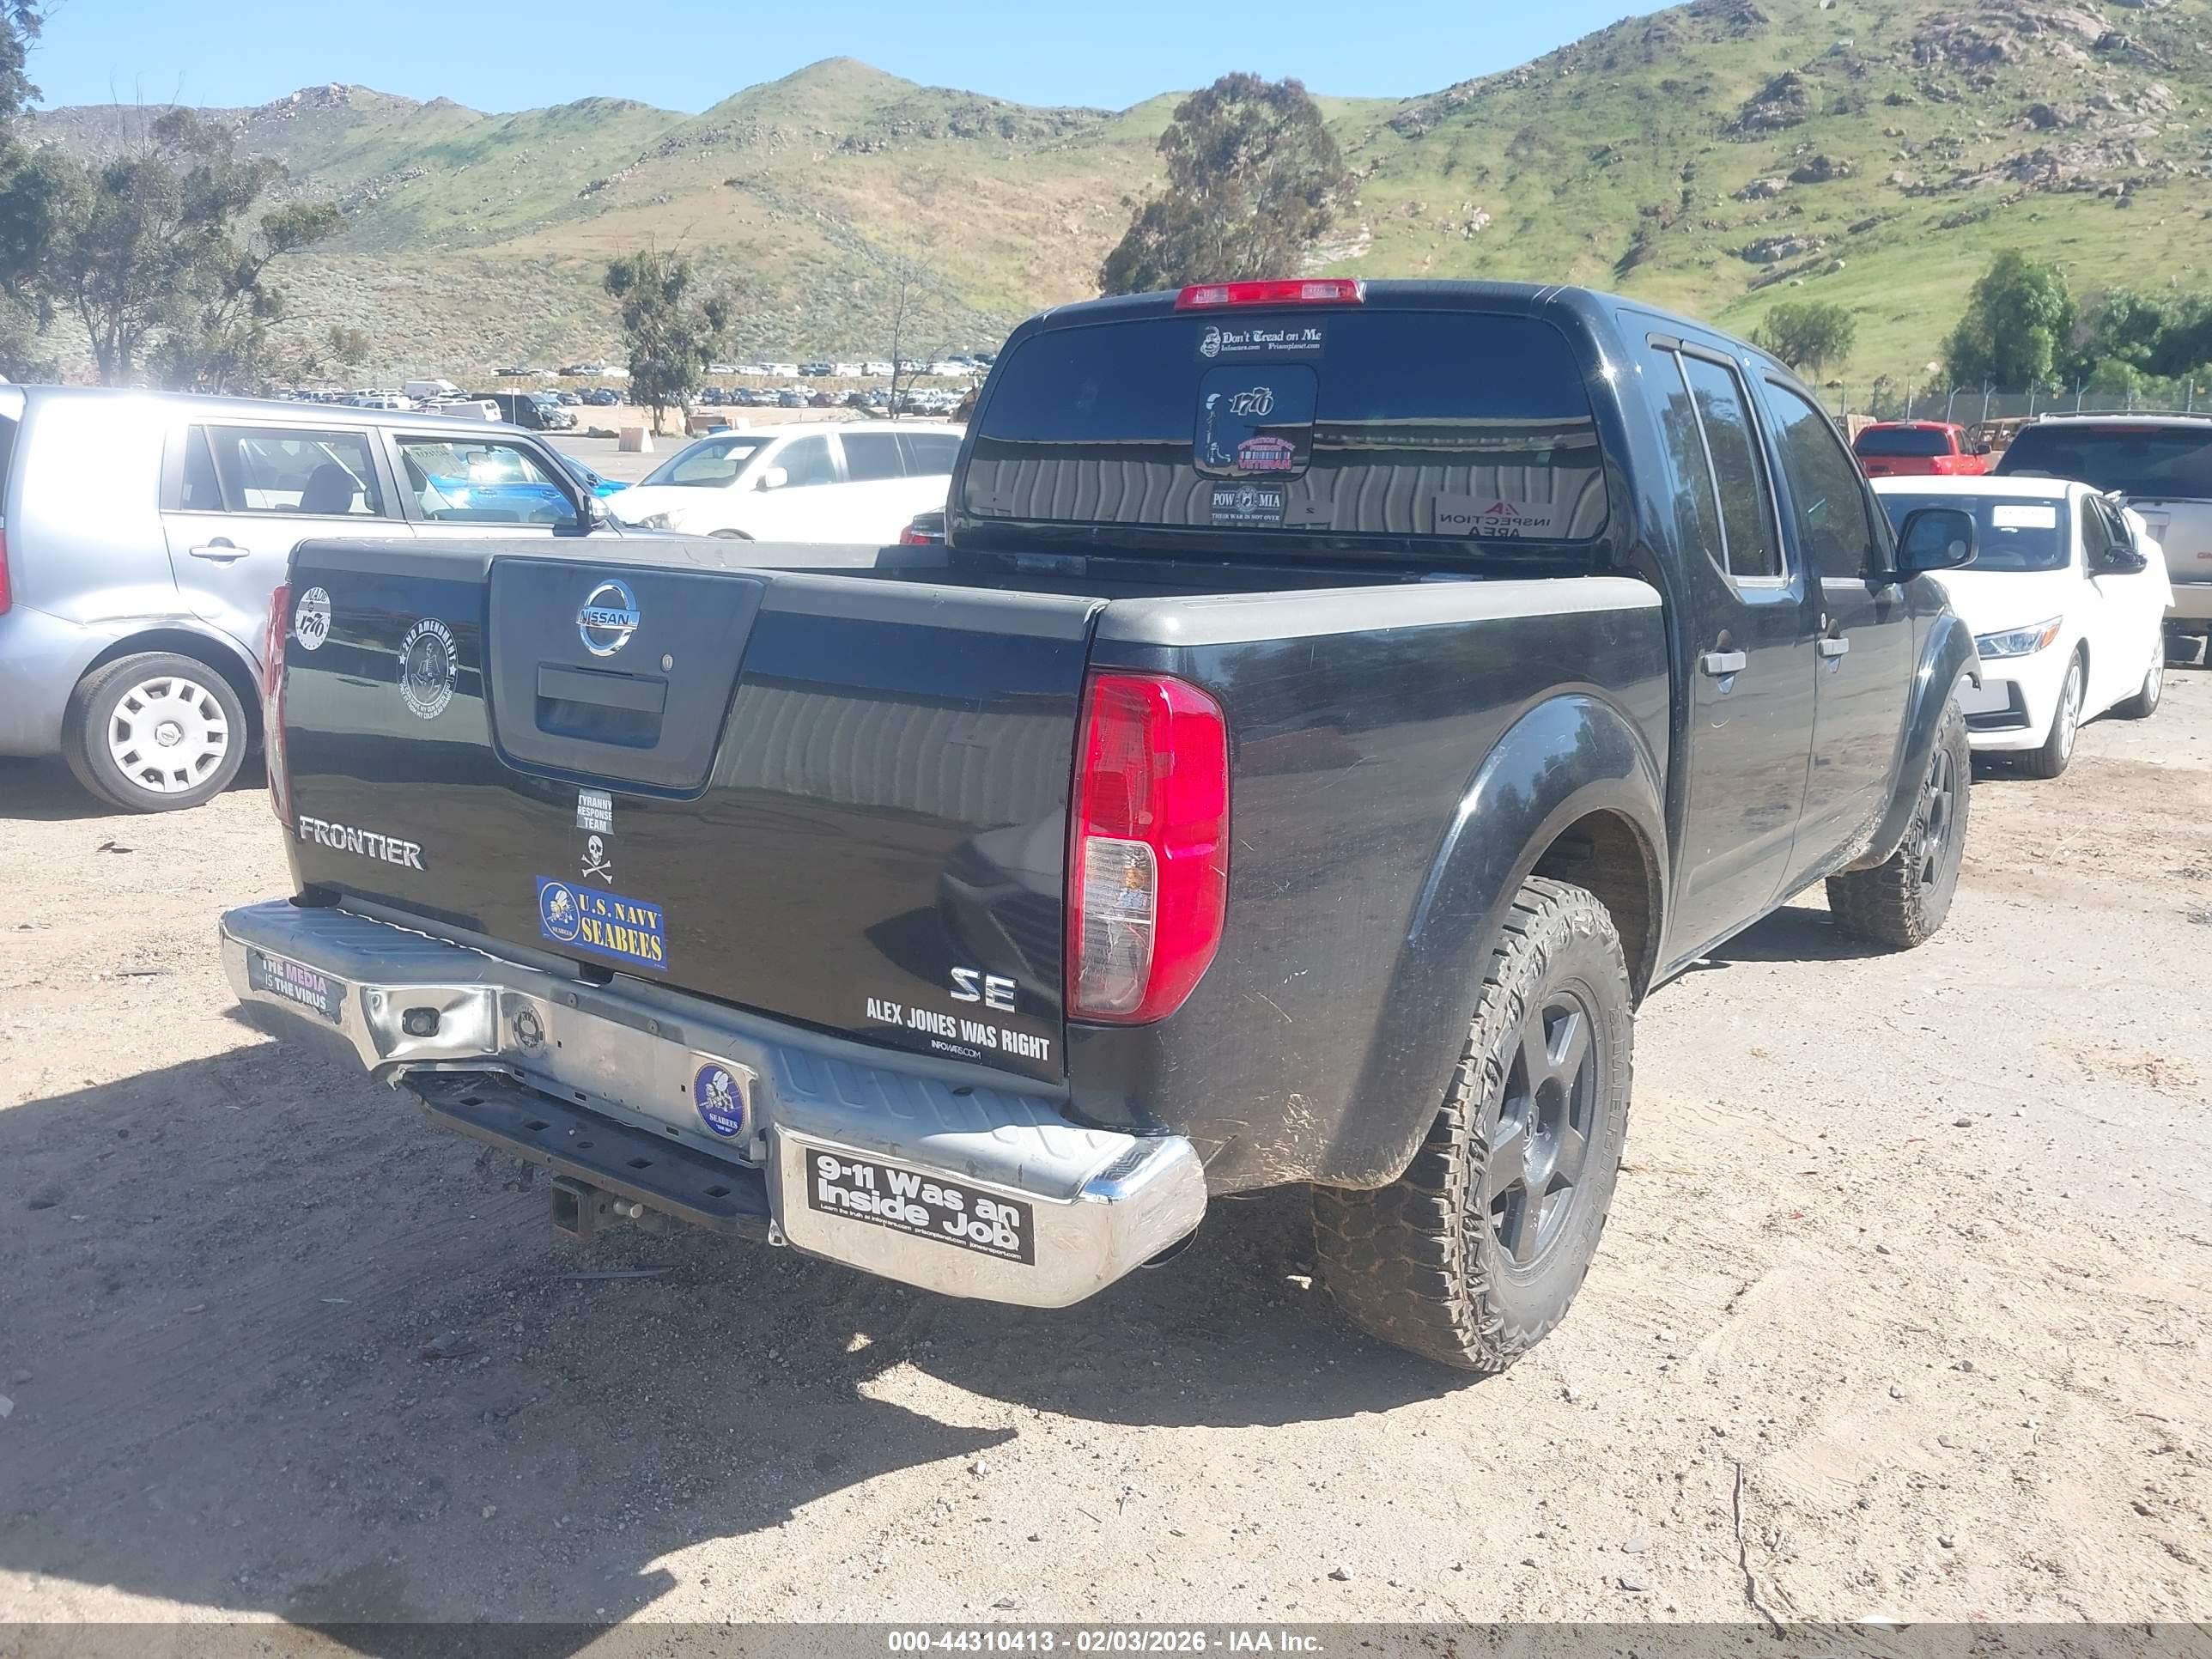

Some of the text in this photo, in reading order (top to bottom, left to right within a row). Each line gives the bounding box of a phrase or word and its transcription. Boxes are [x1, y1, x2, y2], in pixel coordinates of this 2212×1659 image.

[1222, 331, 1250, 343] Don't
[1253, 330, 1285, 342] Tread
[1302, 329, 1322, 341] Me
[1212, 493, 1236, 506] POW
[1259, 494, 1280, 507] MIA
[300, 612, 325, 638] 1776
[579, 610, 629, 625] NISSAN
[403, 620, 456, 660] 2ND AMENDMENT
[577, 805, 613, 821] RESPONSE
[578, 794, 612, 811] TYRANNY
[584, 817, 607, 832] TEAM
[299, 814, 426, 872] FRONTIER
[579, 893, 658, 929] U.S. NAVY
[581, 916, 662, 962] SEABEES
[265, 973, 327, 1010] IS THE VIRUS
[286, 963, 327, 994] MEDIA
[950, 966, 1018, 1014] SE
[866, 997, 1050, 1061] ALEX JONES WAS RIGHT
[931, 1039, 981, 1060] INFOWARS.COM
[709, 1113, 738, 1129] SEABEES
[817, 1155, 1020, 1228] 9-11 Was an
[817, 1177, 1020, 1251] Inside Job
[820, 1203, 838, 1213] Learn
[849, 1210, 863, 1218] truth
